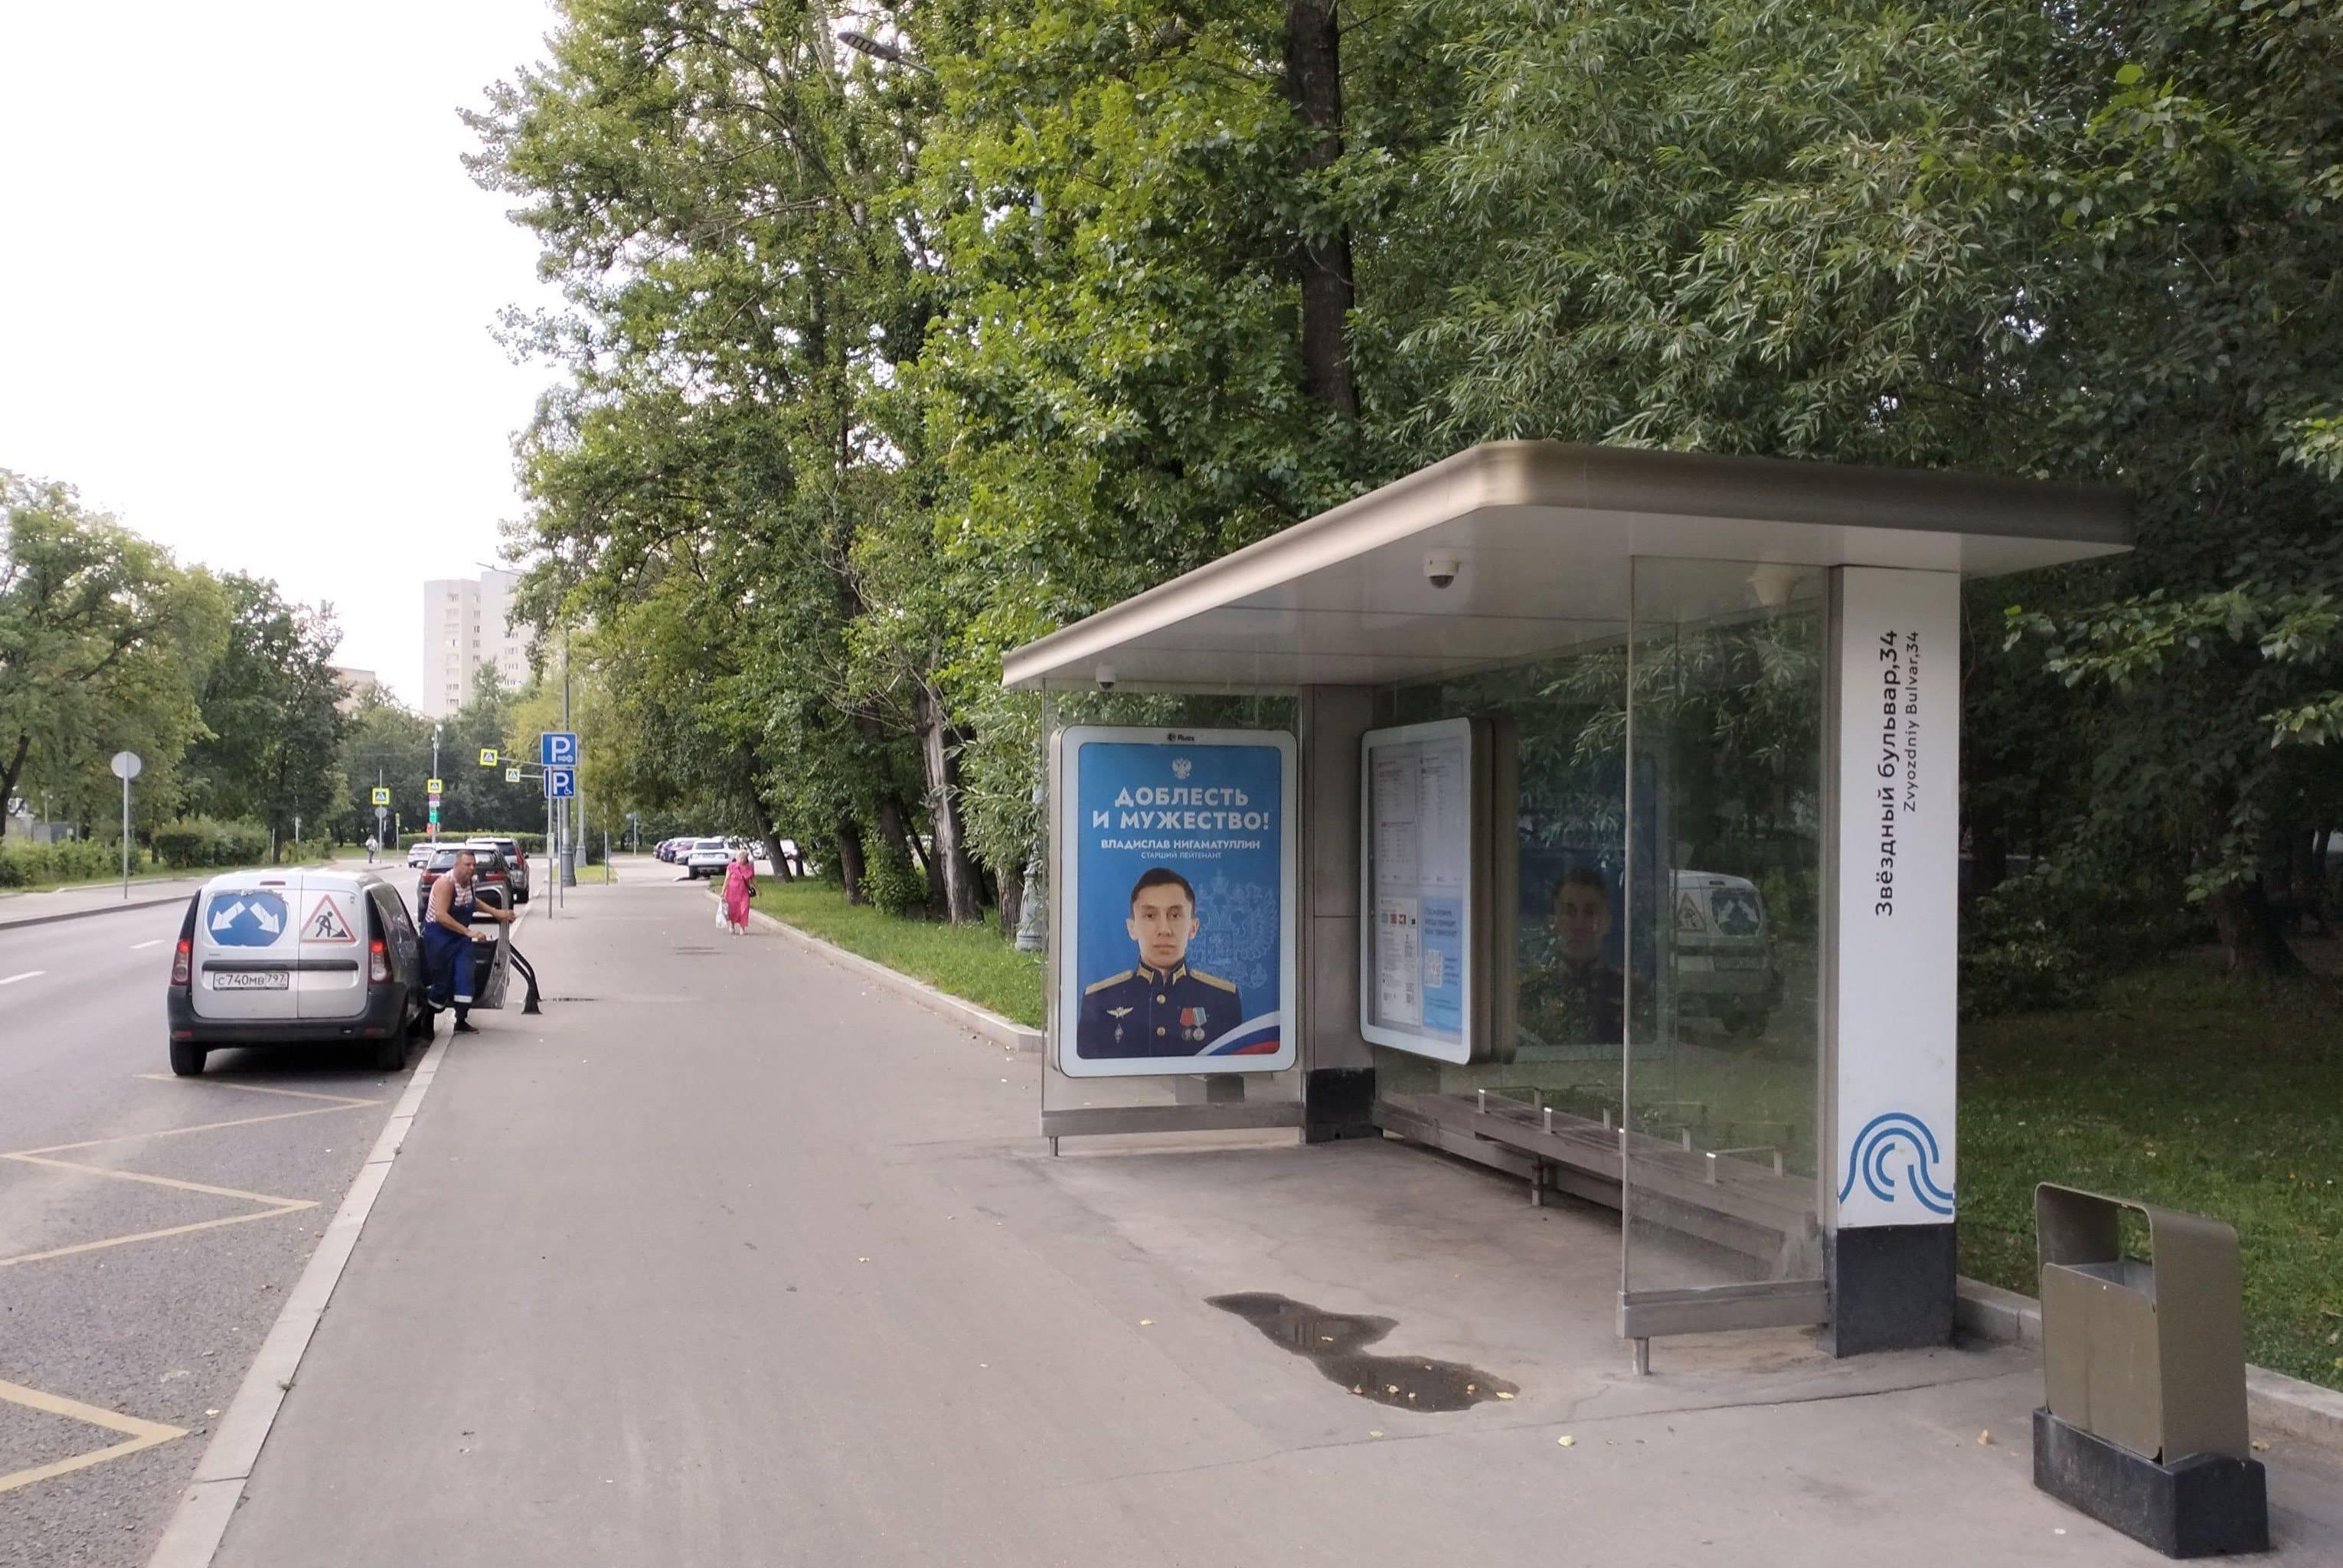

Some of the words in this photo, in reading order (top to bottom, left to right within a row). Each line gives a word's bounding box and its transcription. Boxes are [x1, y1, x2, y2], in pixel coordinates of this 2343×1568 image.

[1905, 631, 1920, 714] Bulvar,34
[1877, 630, 1900, 778] бульвар,34
[1903, 720, 1920, 812] Zvyozdniy
[1093, 810, 1109, 828] И
[1119, 810, 1269, 830] МУЖЕСТВО!
[1114, 786, 1249, 808] ДОБЛЕСТЬ
[1101, 839, 1170, 850] ВЛАДИСЛАВ
[1173, 839, 1260, 850] НИГАМАТУЛЛИН
[1141, 851, 1178, 859] СТАРШИЙ
[1875, 787, 1897, 916] Звёздный
